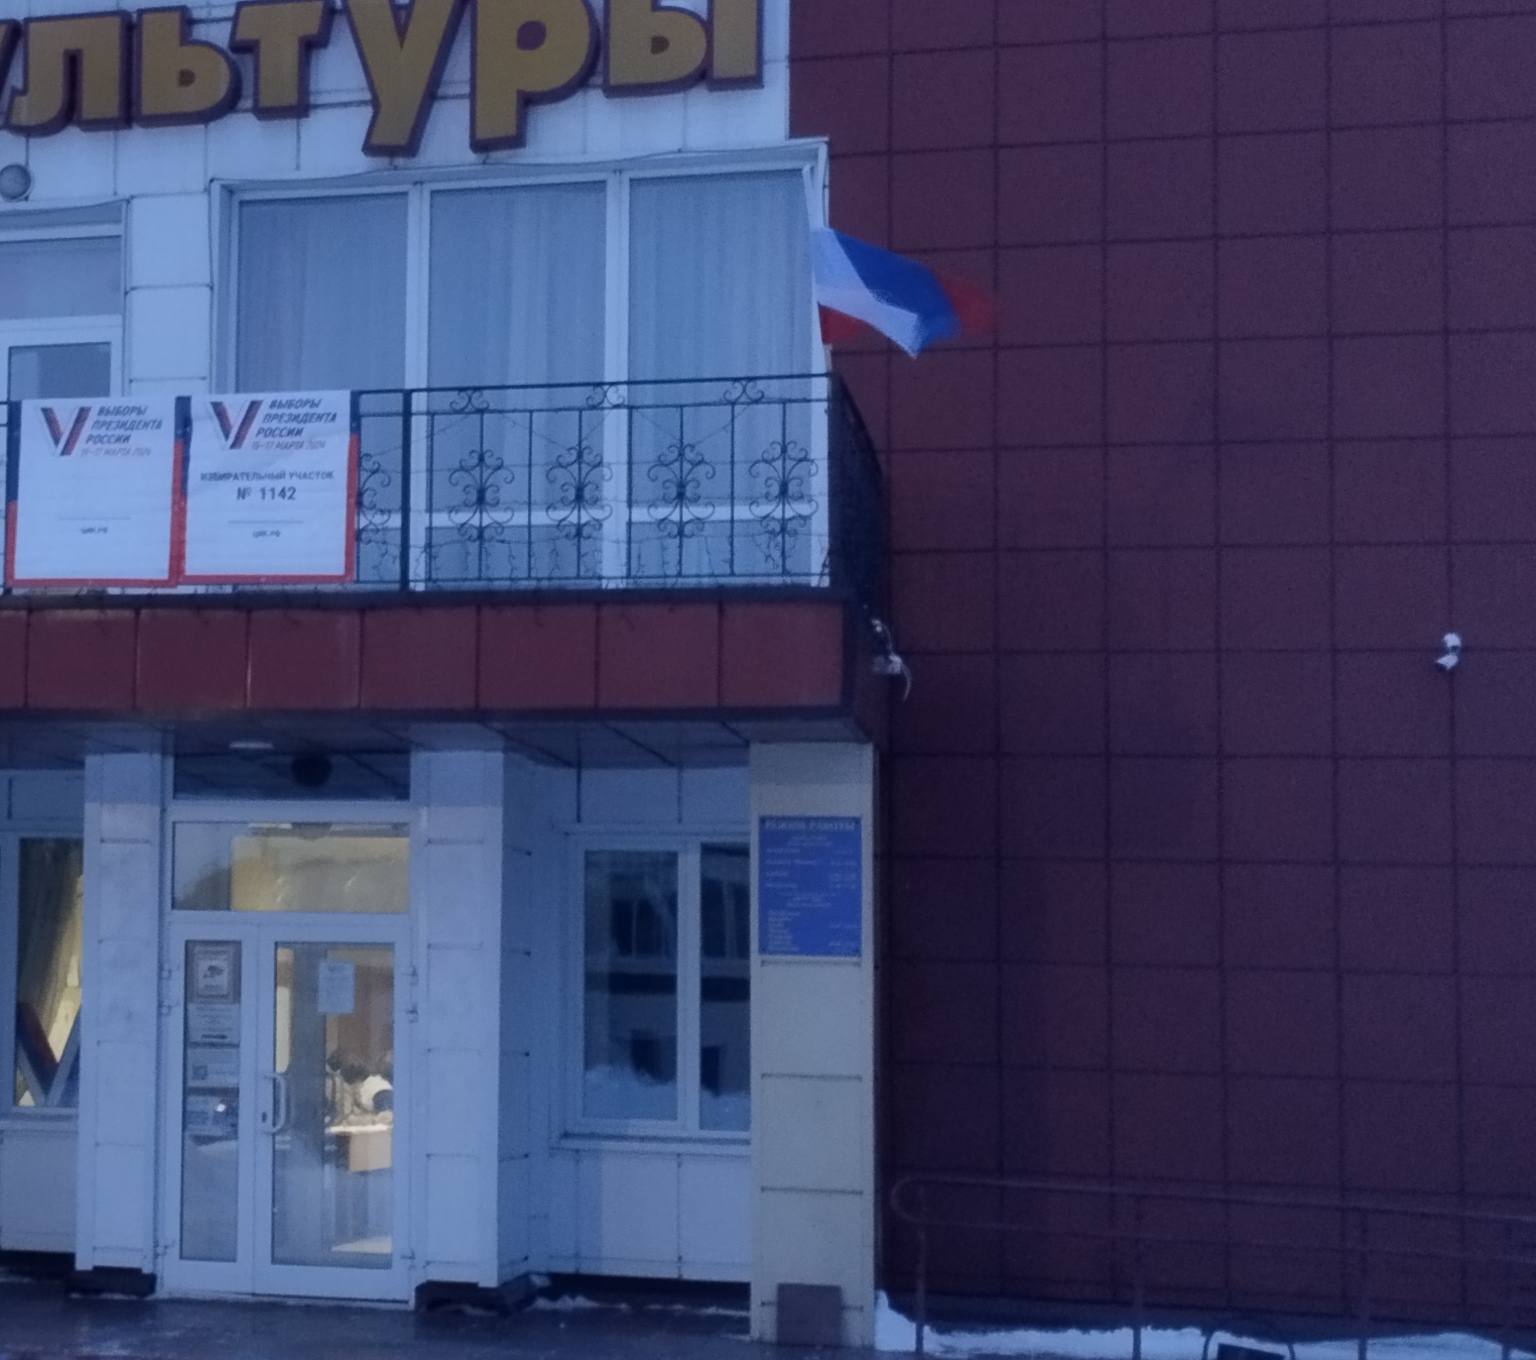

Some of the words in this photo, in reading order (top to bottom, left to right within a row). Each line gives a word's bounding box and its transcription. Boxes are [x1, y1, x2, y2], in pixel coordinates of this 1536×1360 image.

[268, 398, 322, 410] ВЫБОРЫ
[97, 405, 149, 417] ВЫБОРЫ
[261, 412, 337, 425] ПРЕЗИДЕНТА
[90, 419, 163, 432] ПРЕЗИДЕНТА
[85, 433, 132, 445] РОССИИ
[255, 426, 304, 439] РОССИИ
[200, 469, 286, 482] ИЗБИРАТЕЛЬНЫЙ
[288, 469, 335, 481] УЧАСТОК
[236, 486, 252, 501] №
[259, 485, 297, 501] 1142
